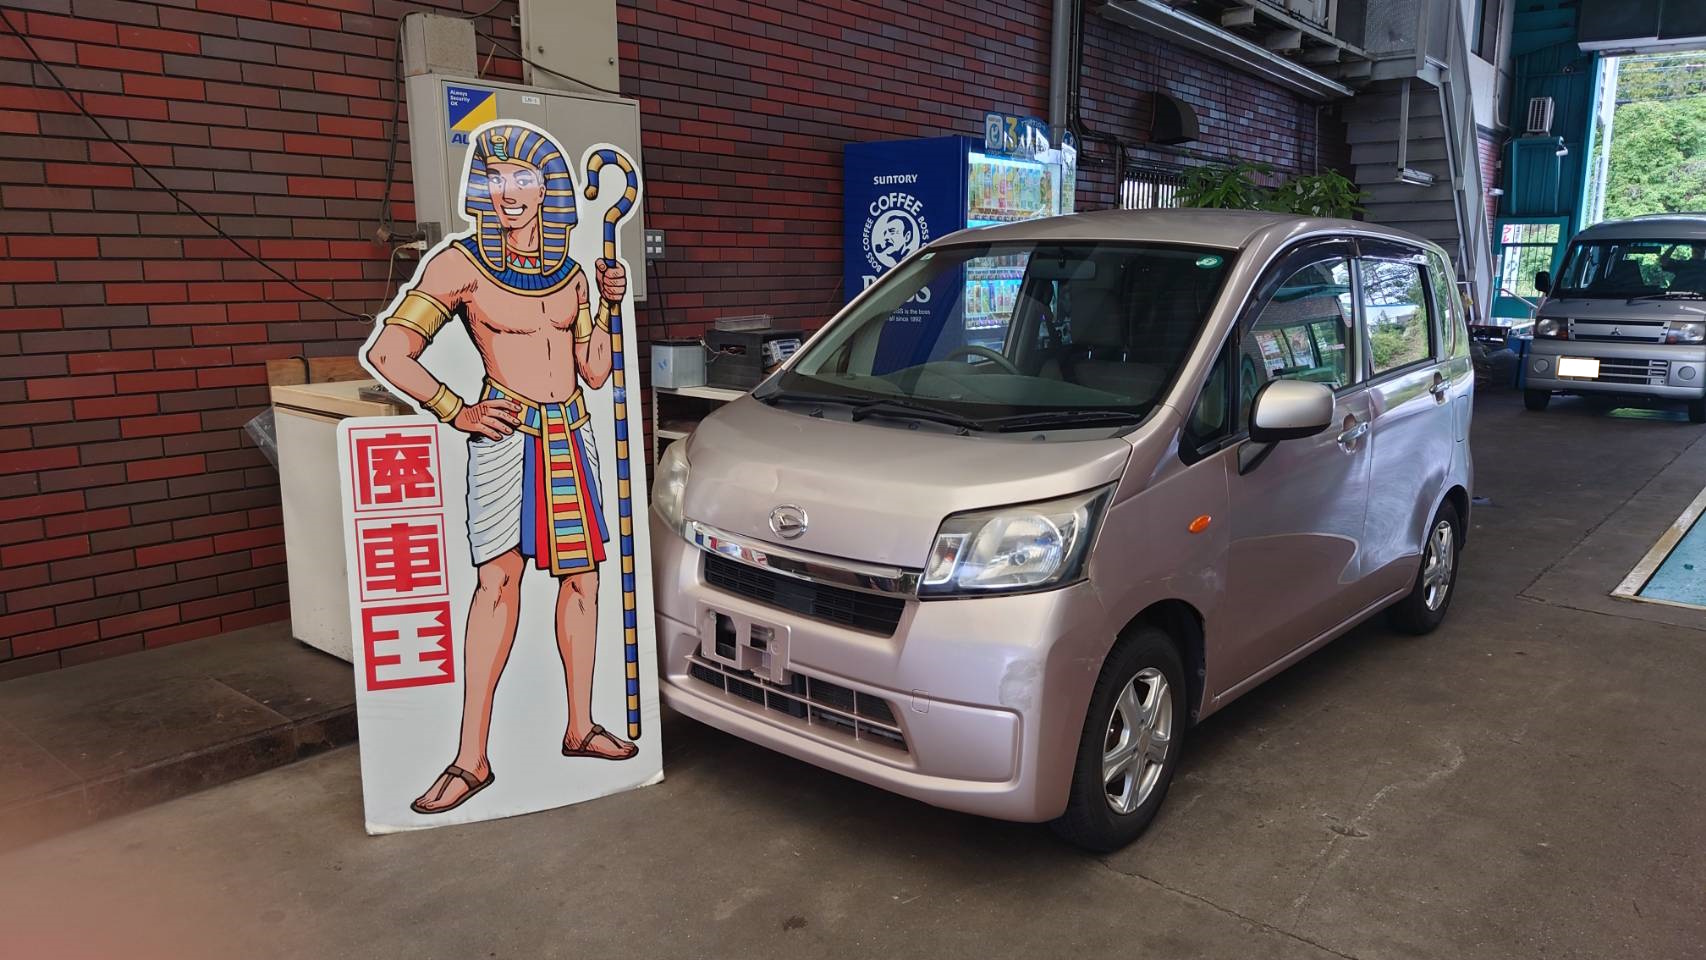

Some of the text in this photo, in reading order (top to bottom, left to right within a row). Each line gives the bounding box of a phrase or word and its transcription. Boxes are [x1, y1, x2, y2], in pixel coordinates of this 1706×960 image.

[869, 192, 923, 217] COFFEE
[862, 217, 883, 273] BOSS COFFEE
[917, 215, 930, 241] BOSS
[354, 428, 455, 691] 廃車王
